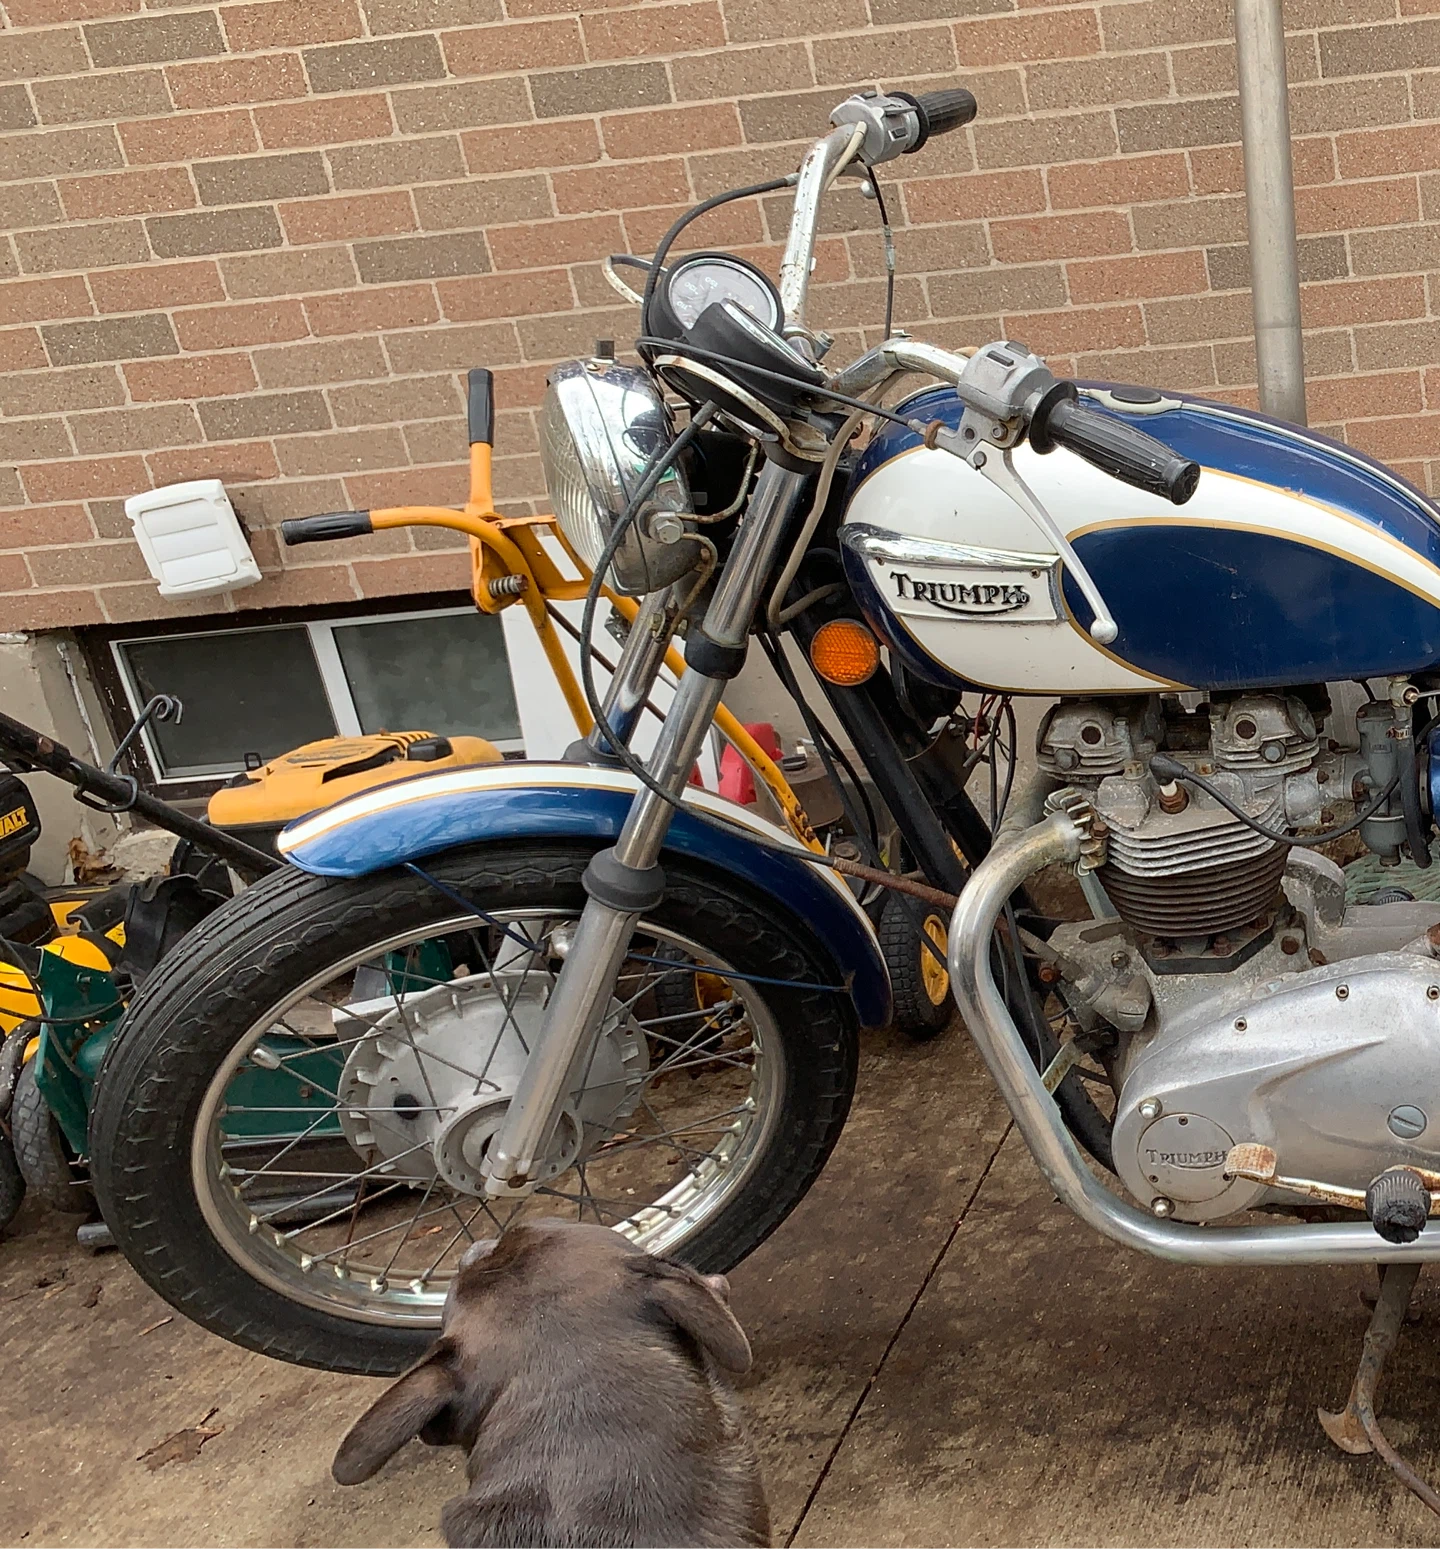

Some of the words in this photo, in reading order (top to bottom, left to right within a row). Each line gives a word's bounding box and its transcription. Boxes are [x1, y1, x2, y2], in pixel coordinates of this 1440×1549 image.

[890, 571, 1031, 616] TRIUMPH
[0, 806, 28, 838] ALT
[1145, 1148, 1228, 1170] TRIUMPH
